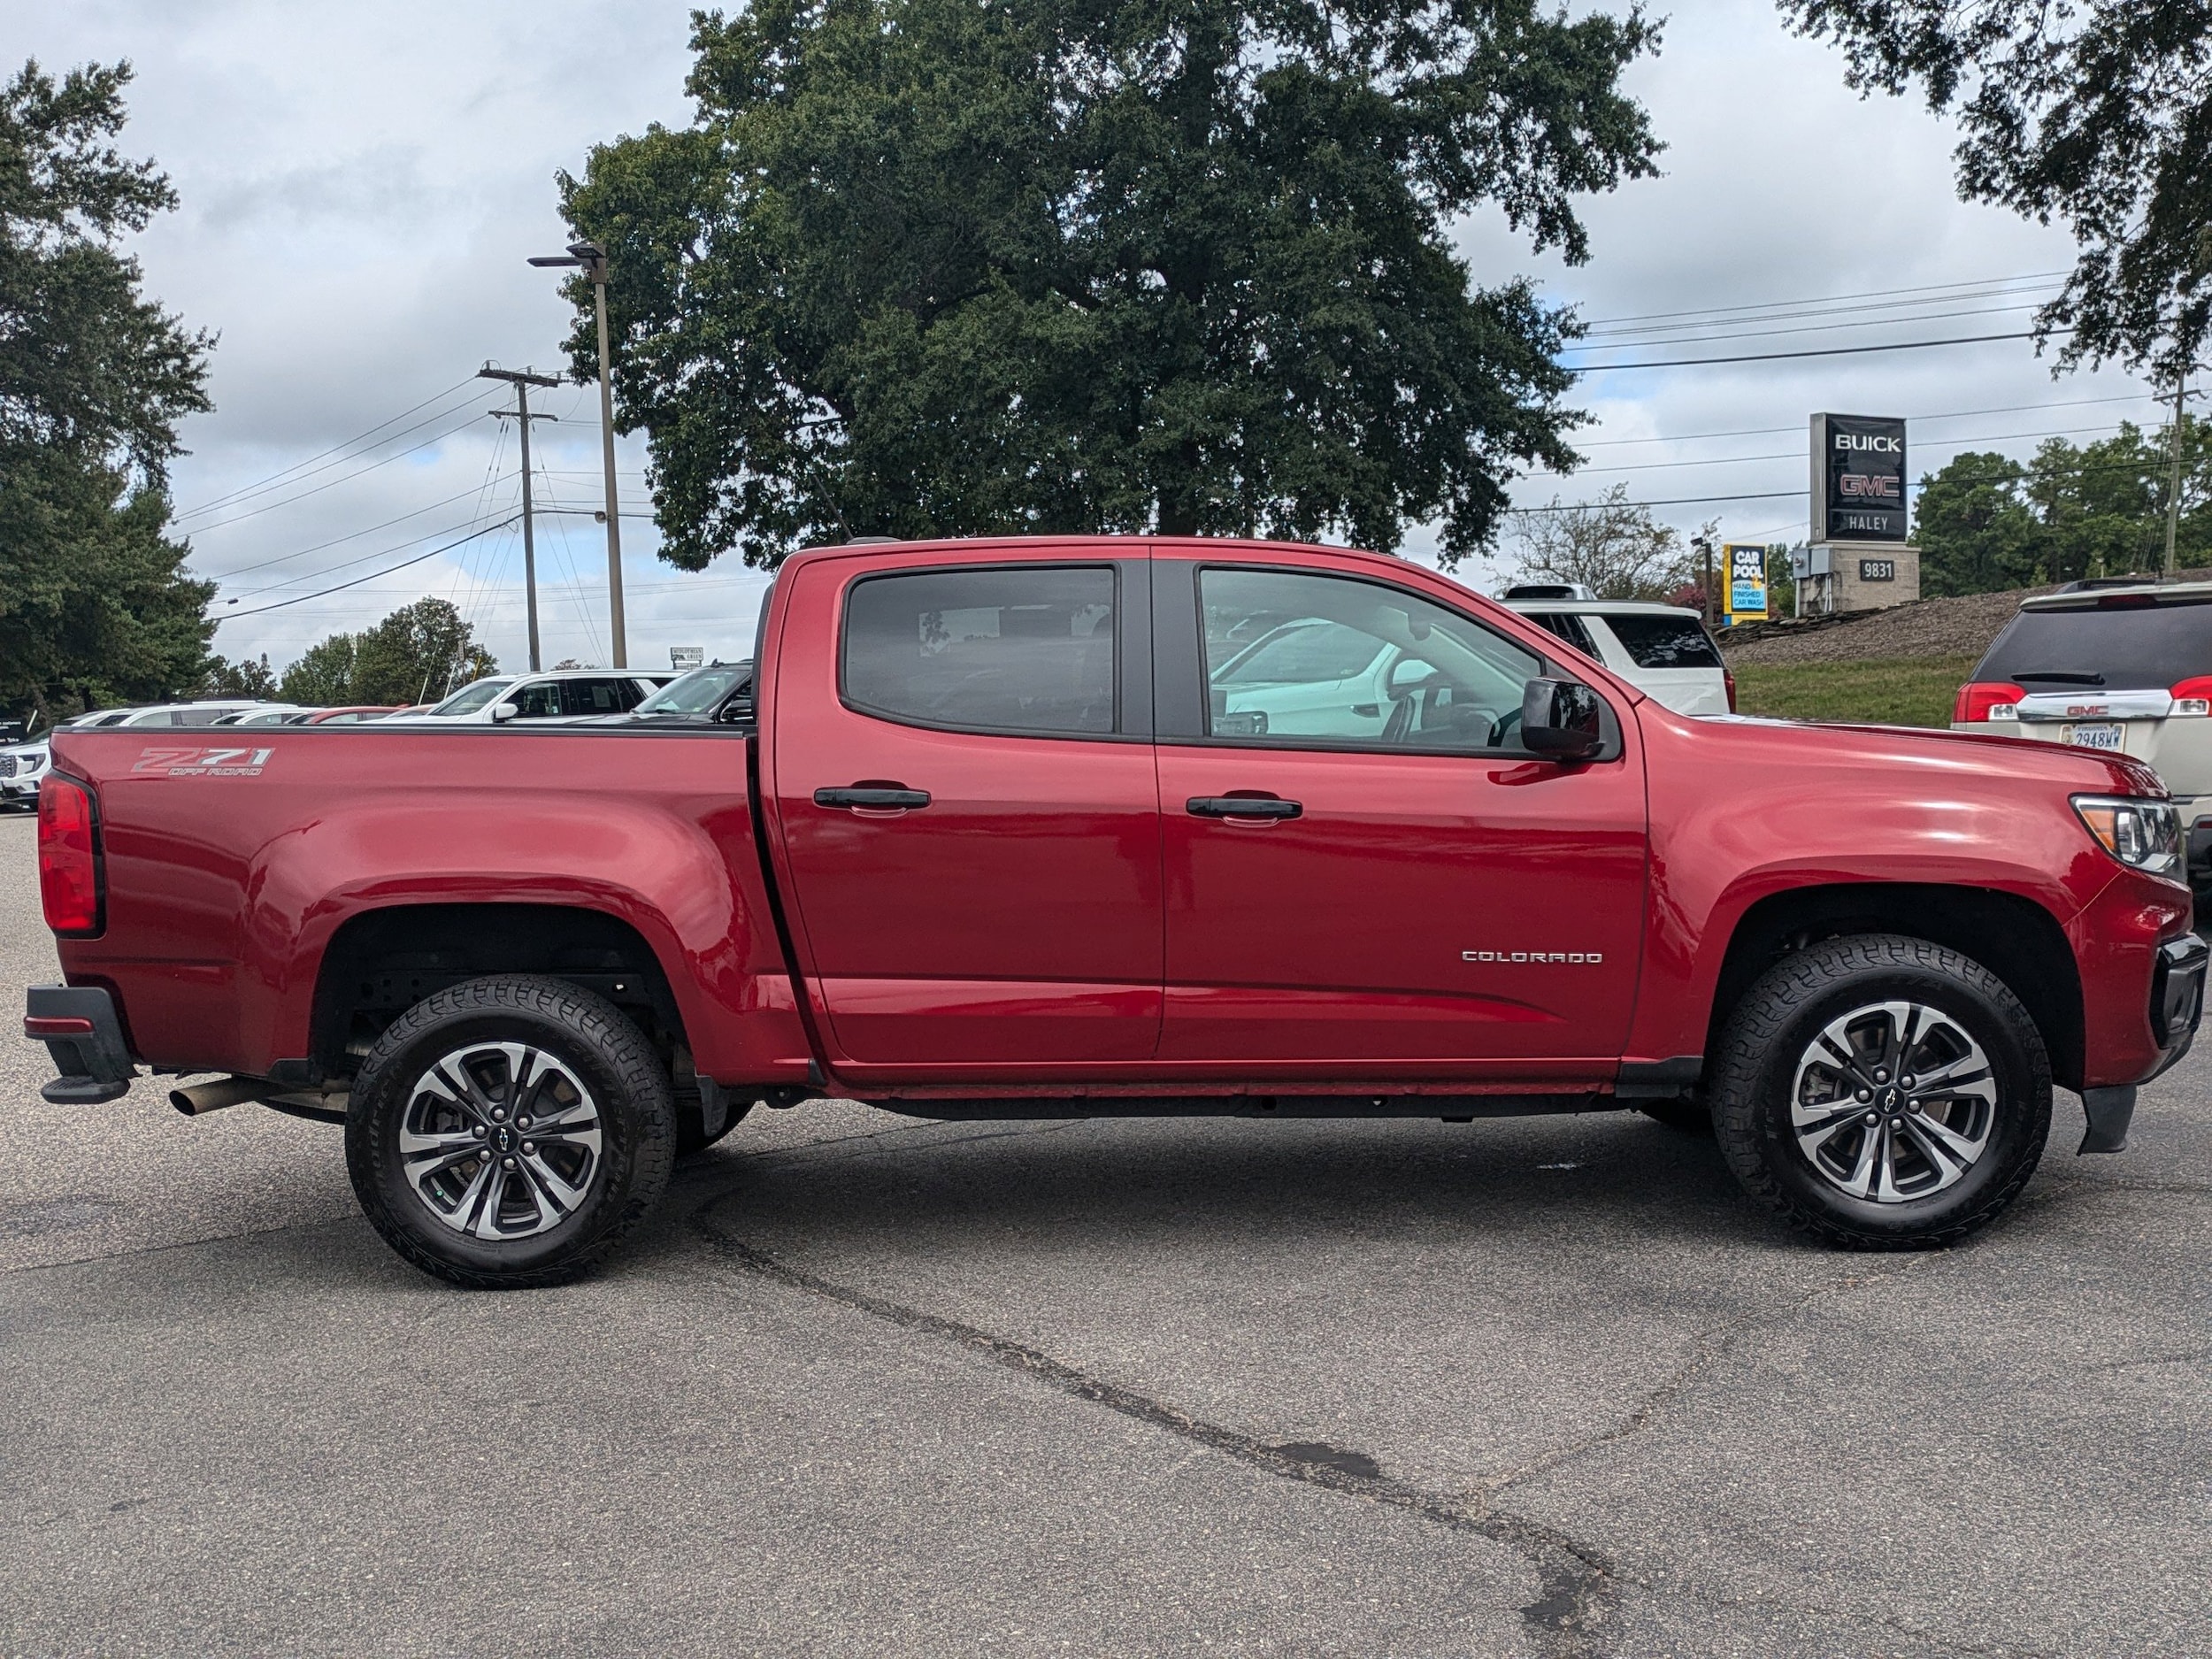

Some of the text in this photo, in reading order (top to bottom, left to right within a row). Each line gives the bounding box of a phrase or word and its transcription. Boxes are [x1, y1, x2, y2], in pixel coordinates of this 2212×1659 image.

[1835, 434, 1901, 453] BUICK
[1840, 473, 1900, 498] GMC
[1848, 516, 1888, 531] HALEY
[1735, 550, 1760, 565] CAR
[1732, 565, 1763, 578] POOL
[1864, 562, 1893, 578] 9831
[2067, 705, 2109, 716] GMC
[131, 747, 276, 772] Z71
[168, 767, 263, 776] OFF ROAD
[1462, 950, 1603, 964] COLORADO
